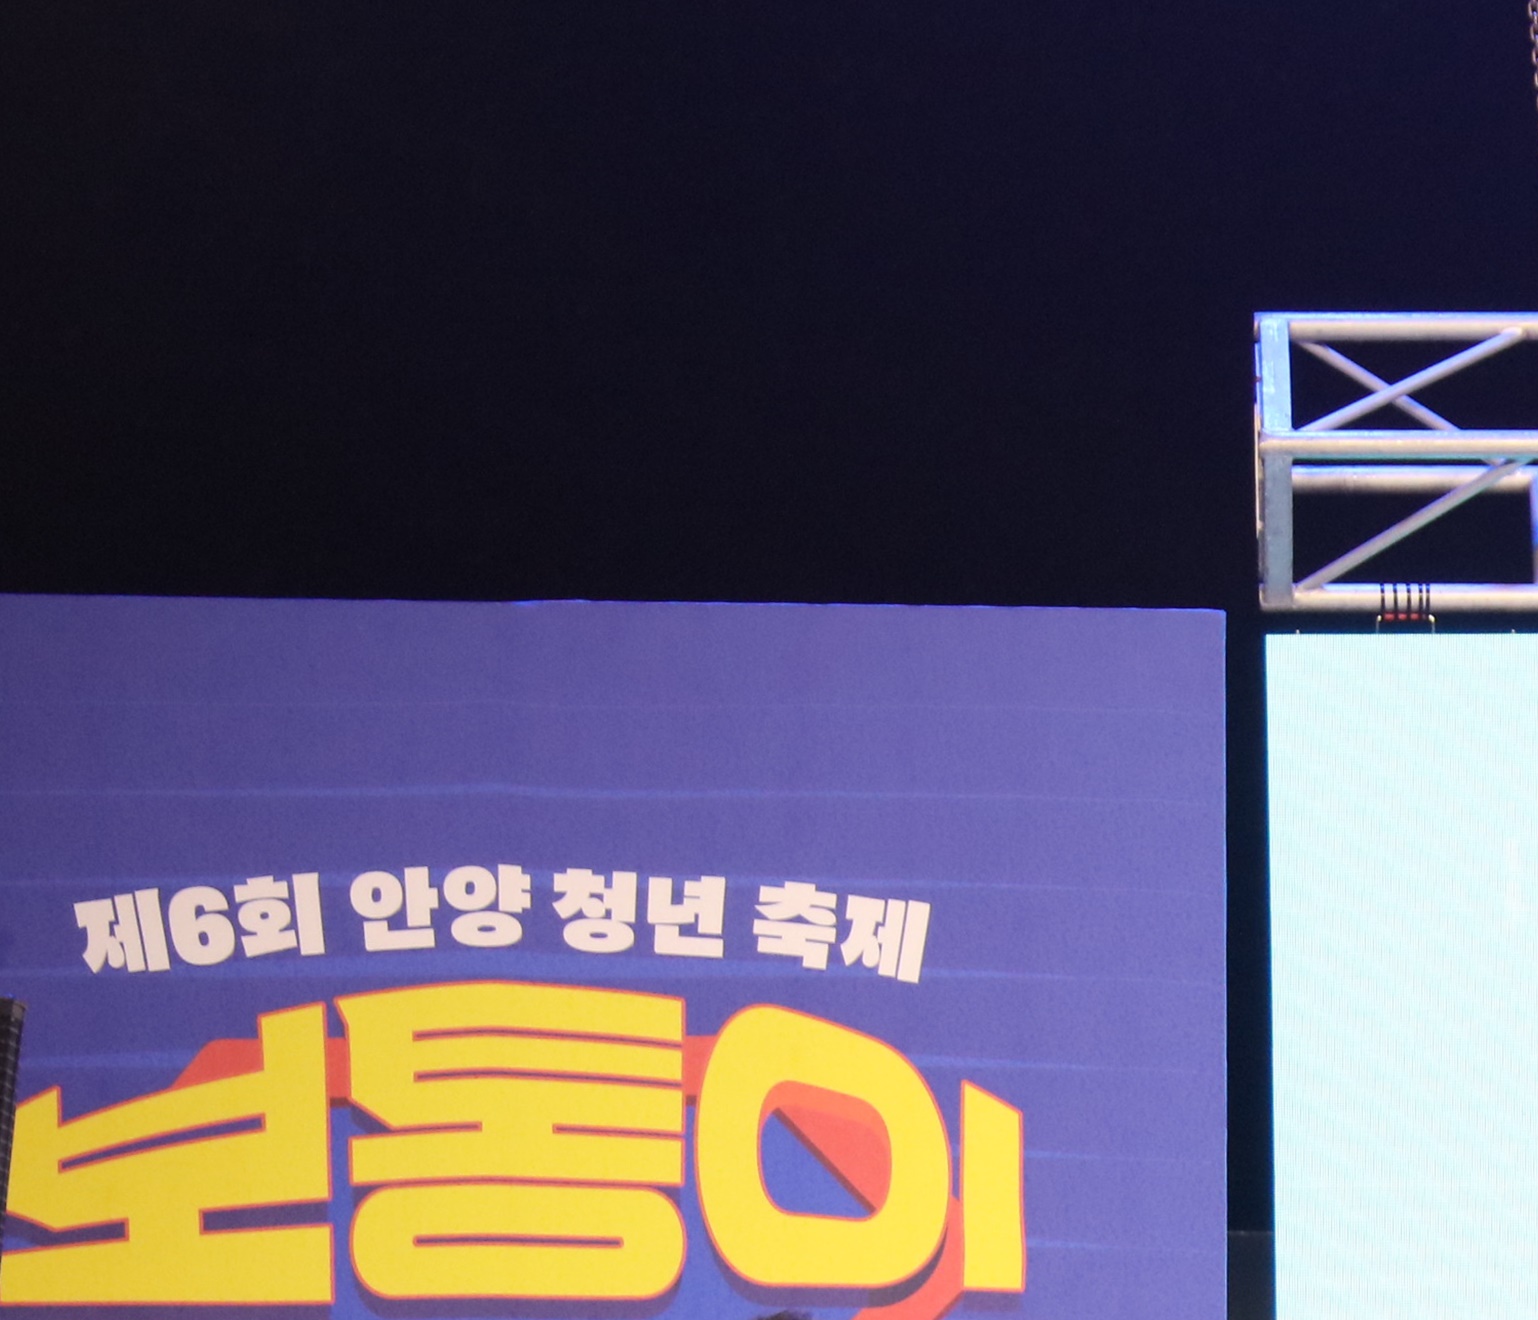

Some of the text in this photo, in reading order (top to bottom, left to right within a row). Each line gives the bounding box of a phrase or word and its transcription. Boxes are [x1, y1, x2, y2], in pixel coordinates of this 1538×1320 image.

[73, 864, 932, 984] 제6회 안양 청년 축제
[0, 980, 1026, 1305] 보통이
